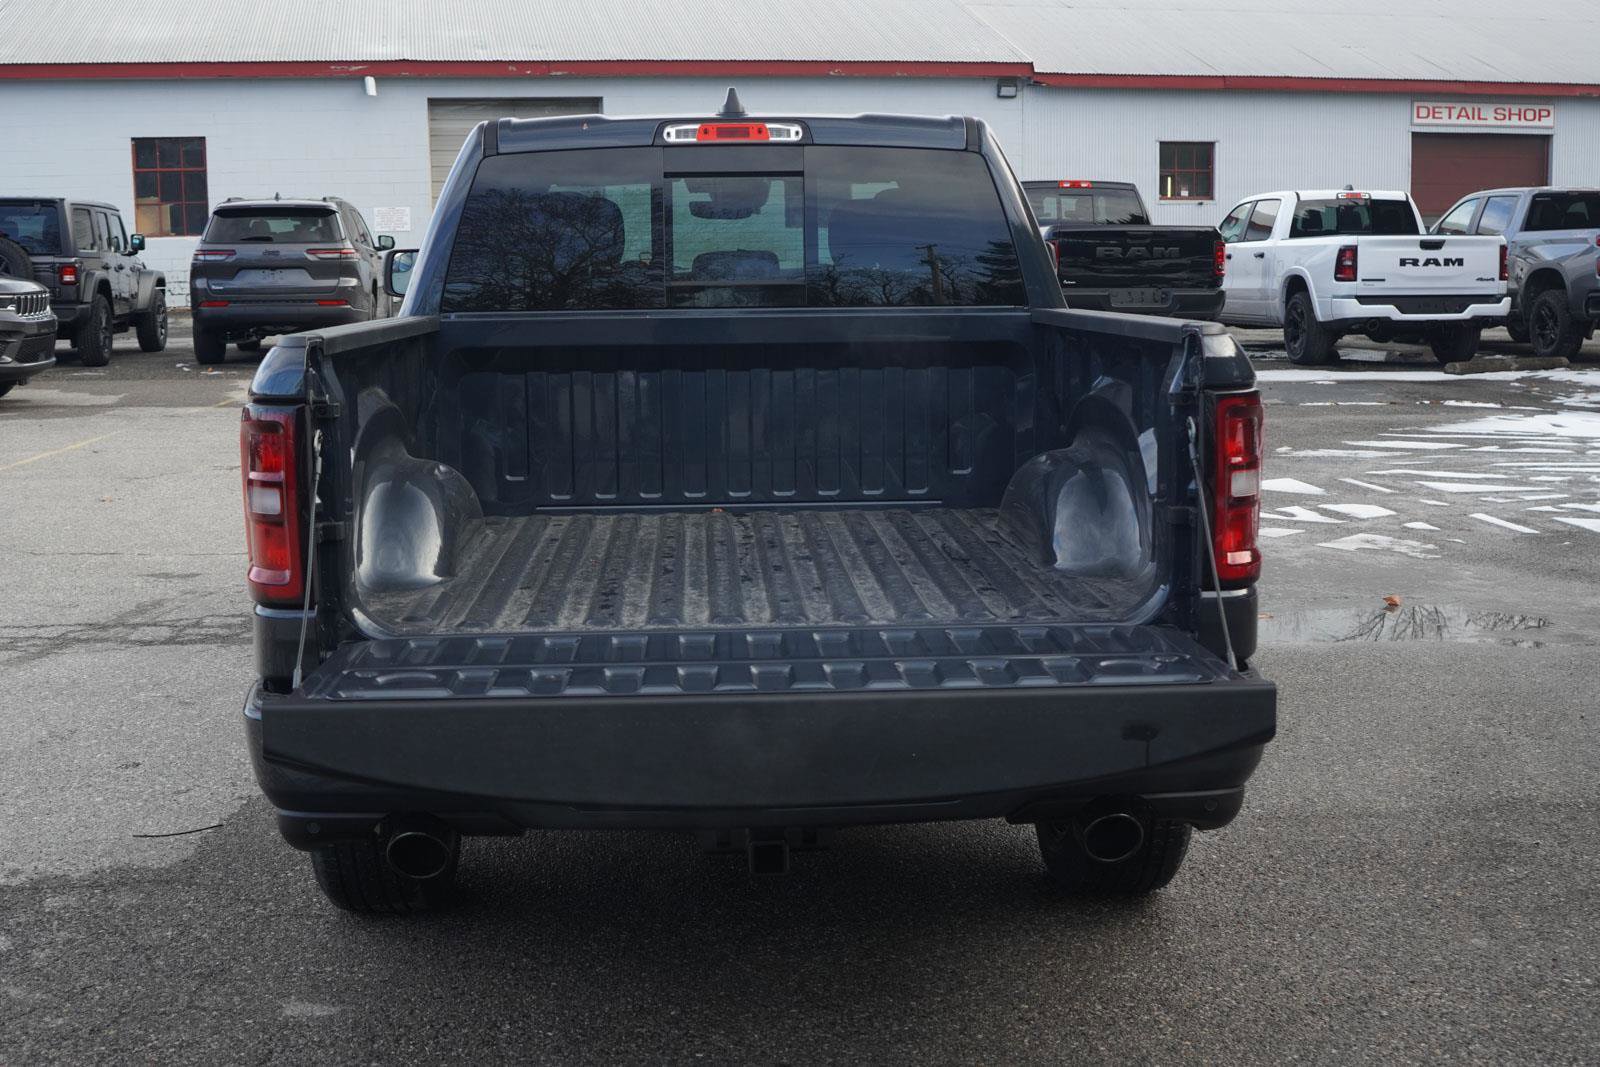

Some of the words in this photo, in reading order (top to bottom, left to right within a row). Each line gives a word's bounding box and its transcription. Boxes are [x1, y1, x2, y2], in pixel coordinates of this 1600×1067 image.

[1416, 105, 1488, 121] DETAIL
[1493, 107, 1551, 122] SHOP
[1095, 246, 1180, 259] RAM
[1399, 257, 1464, 267] RAM
